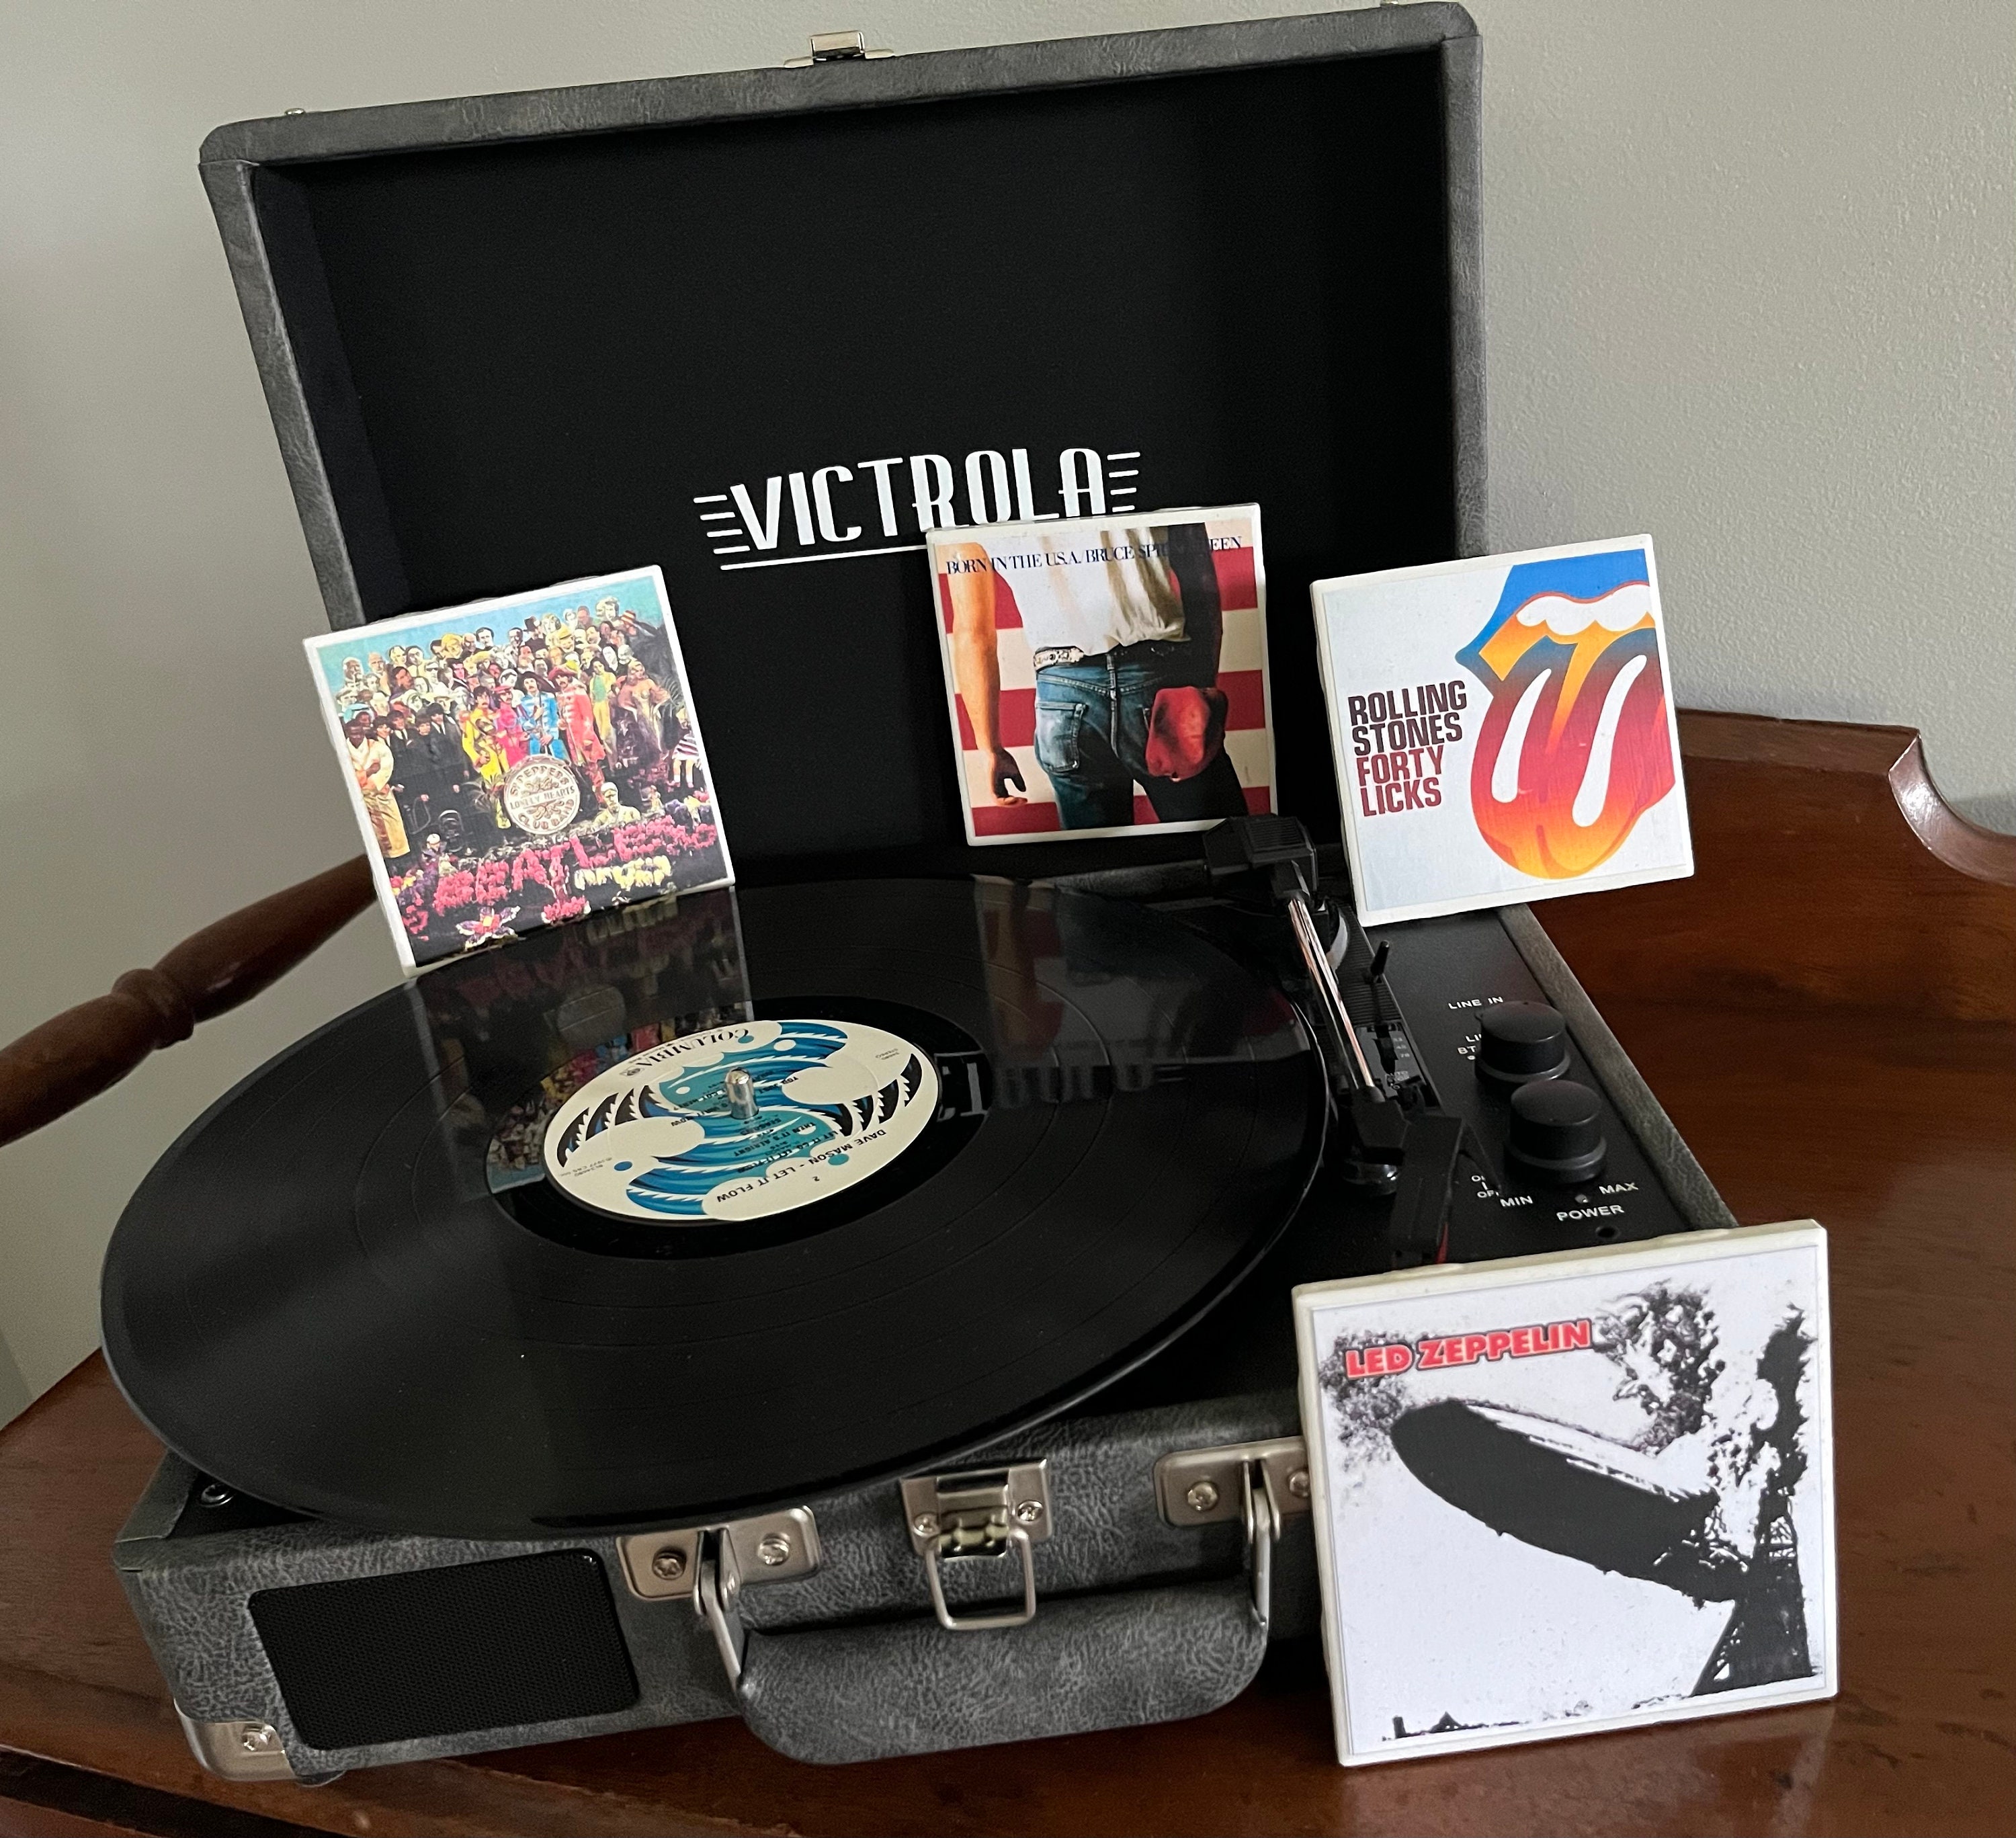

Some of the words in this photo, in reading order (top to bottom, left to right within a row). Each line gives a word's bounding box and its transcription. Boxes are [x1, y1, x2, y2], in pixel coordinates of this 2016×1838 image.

[730, 447, 1107, 550] VICTROLA
[946, 557, 988, 575] BORN
[991, 556, 1008, 571] IN
[1008, 553, 1043, 569] THE
[1085, 546, 1136, 563] BRUCE
[1347, 680, 1467, 726] ROLLING
[1351, 712, 1463, 756] STONES
[1356, 745, 1444, 786] FORTY
[544, 786, 575, 800] HEARTS
[1360, 776, 1442, 817] LICKS
[1448, 999, 1482, 1009] LINE
[1487, 996, 1504, 1005] IN
[636, 1029, 749, 1067] COLUMBIA
[854, 1129, 886, 1146] DAVE
[808, 1144, 853, 1165] MASON
[757, 1177, 769, 1187] IT
[772, 1167, 796, 1180] LET
[716, 1183, 753, 1202] FLOW
[1599, 1181, 1639, 1195] MAX
[1499, 1196, 1534, 1208] MIN
[1556, 1204, 1625, 1221] POWER
[1345, 1344, 1414, 1380] LED
[1417, 1318, 1593, 1371] ZEPPELIN
